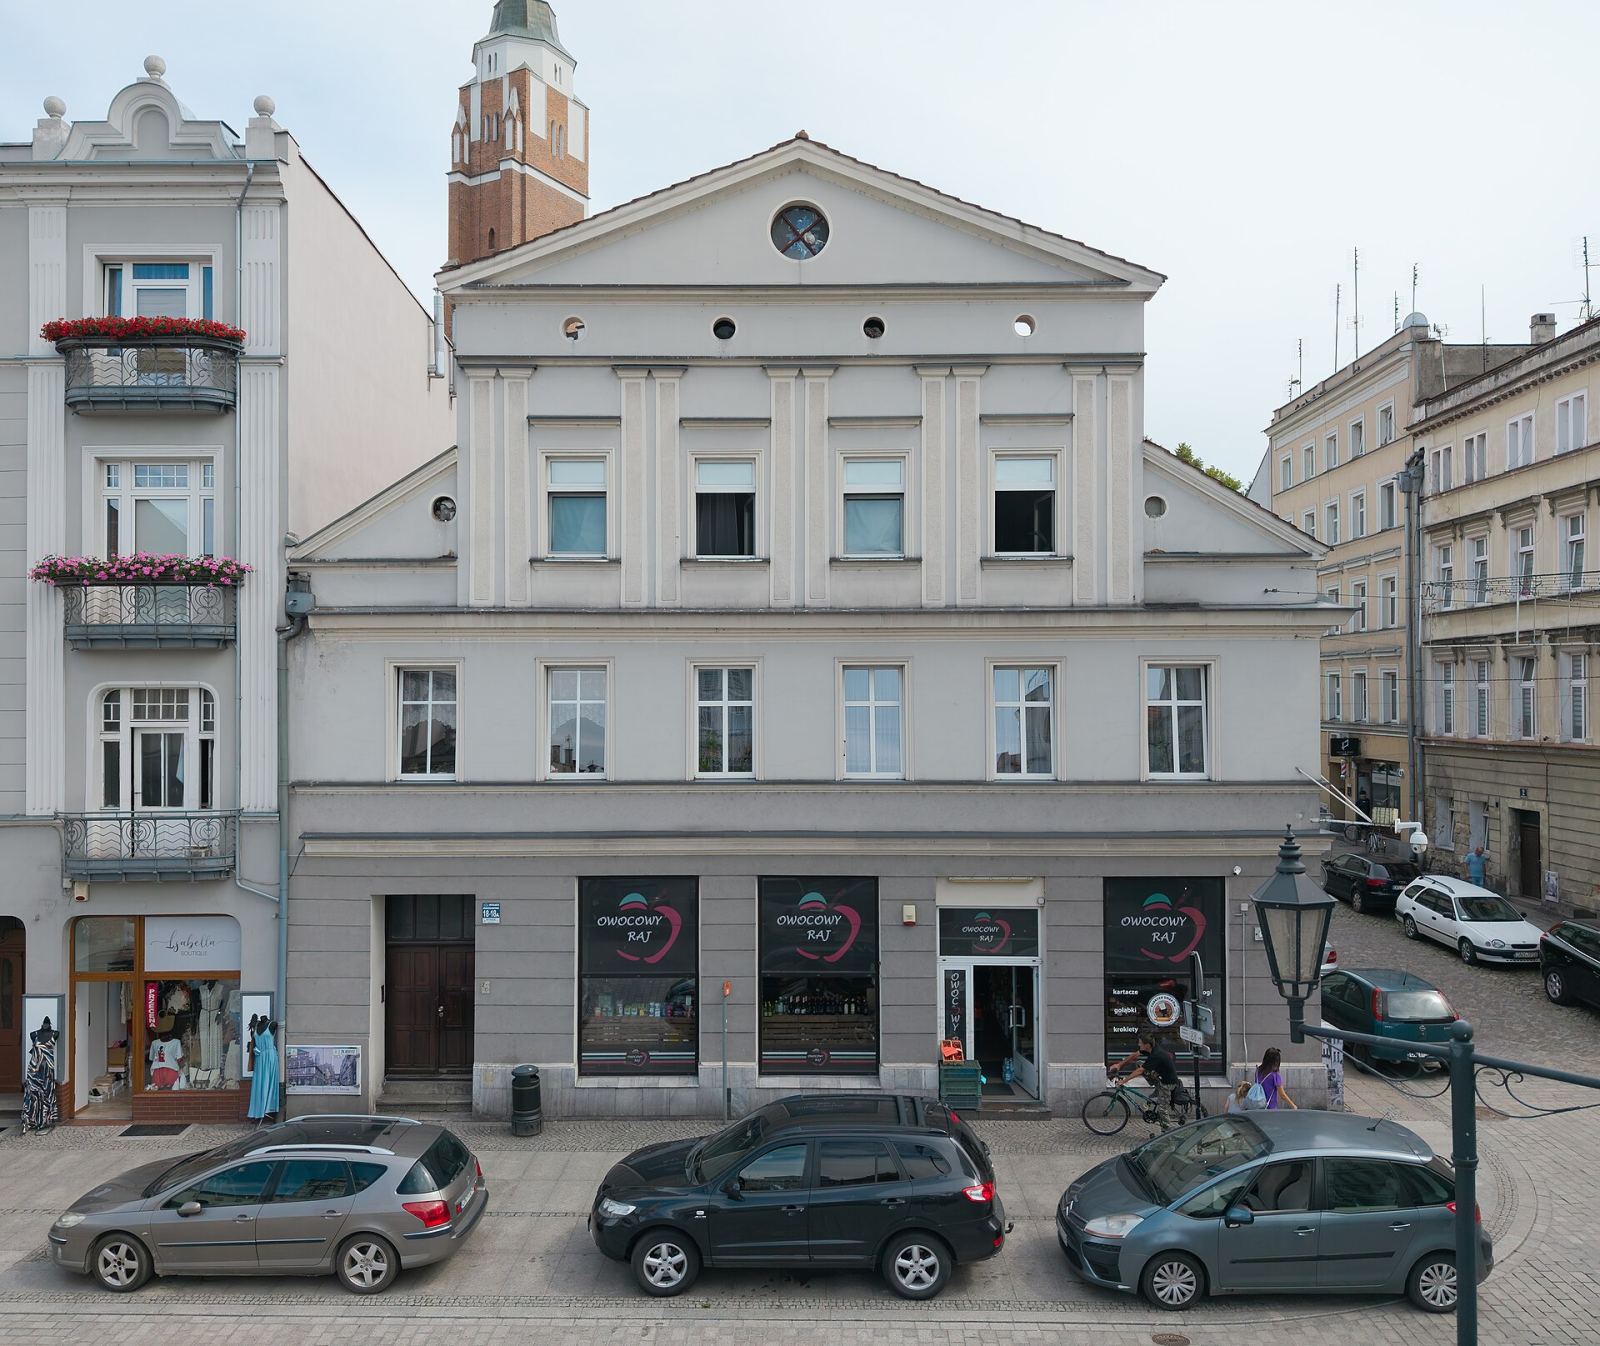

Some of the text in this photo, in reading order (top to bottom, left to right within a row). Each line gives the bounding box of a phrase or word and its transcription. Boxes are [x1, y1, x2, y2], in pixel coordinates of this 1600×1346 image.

[597, 915, 663, 927] OWOCOWY
[776, 914, 842, 926] OWOCOWY
[1121, 916, 1187, 927] OWOCOWY
[627, 931, 652, 943] RAJ
[806, 929, 832, 942] RAJ
[1151, 931, 1177, 944] RAJ
